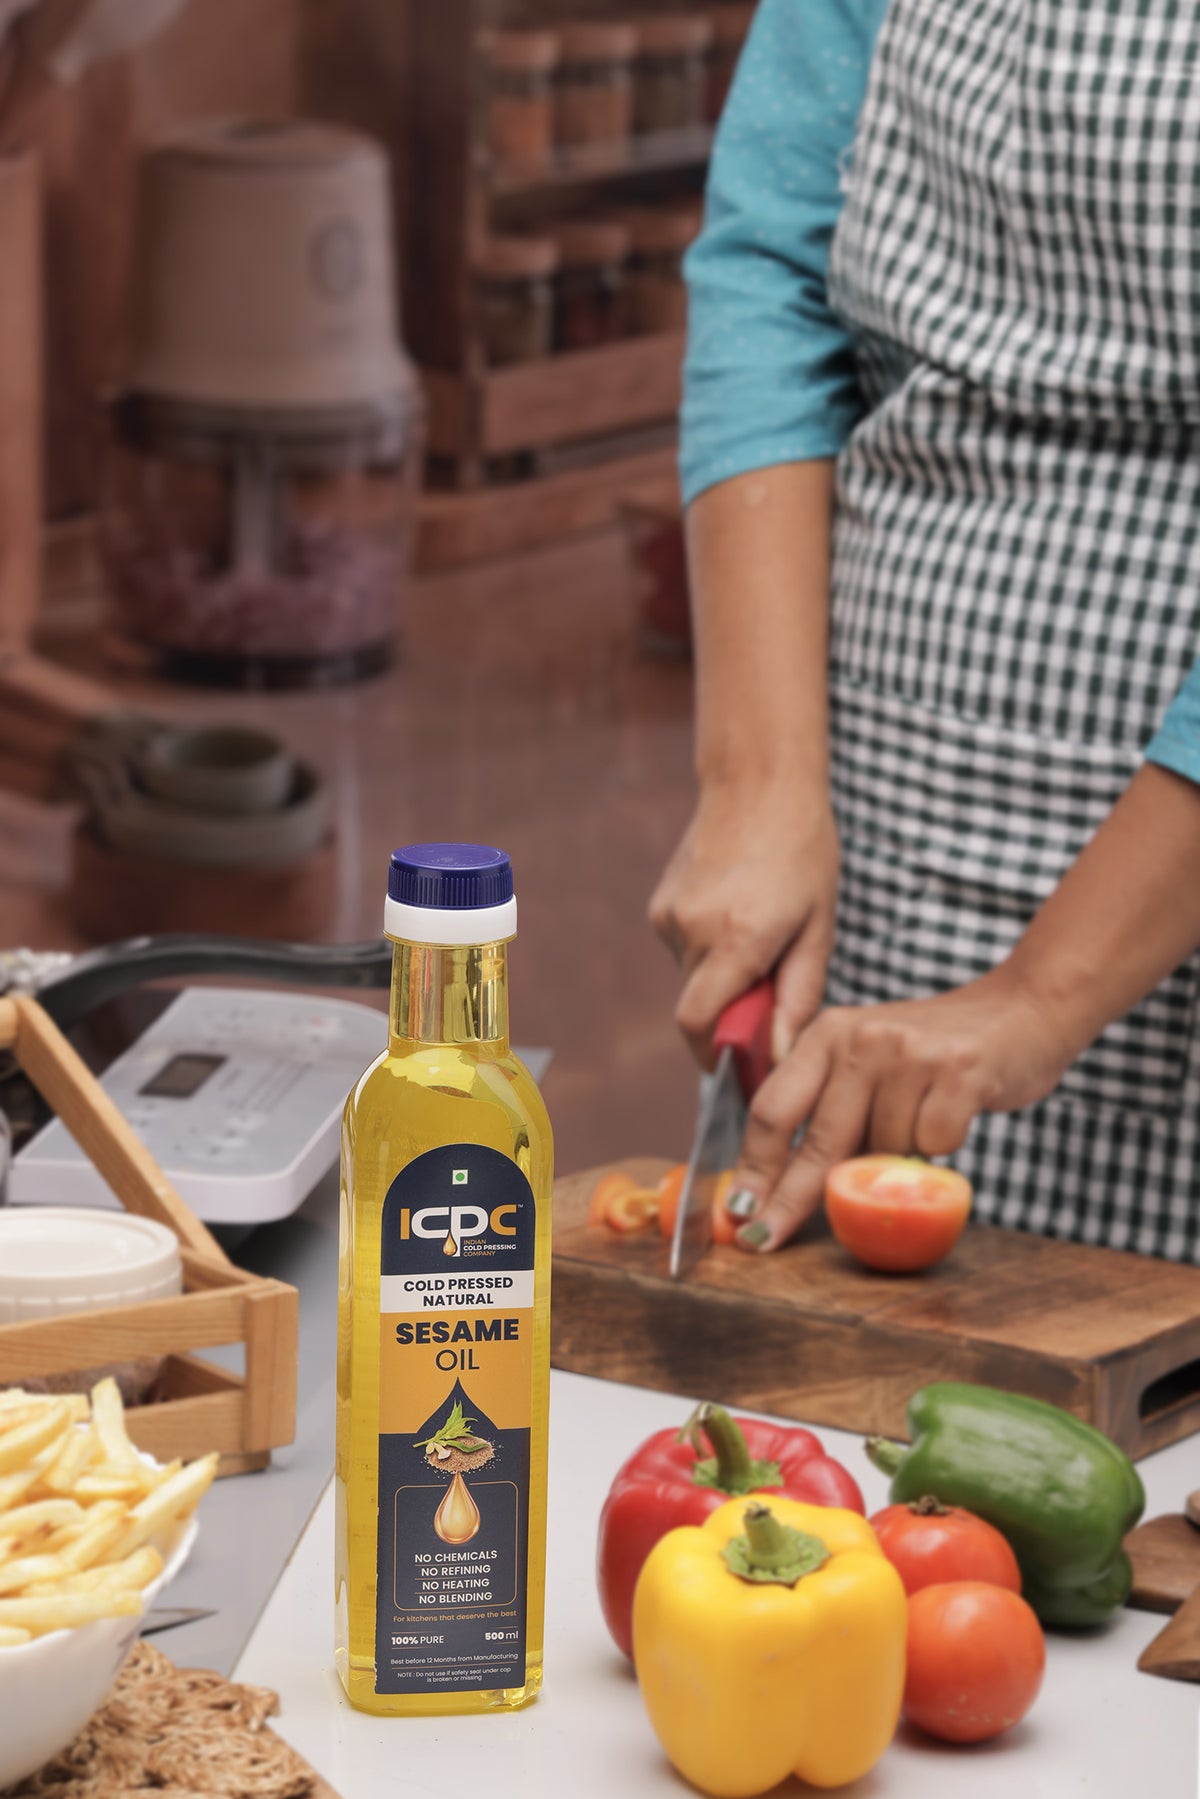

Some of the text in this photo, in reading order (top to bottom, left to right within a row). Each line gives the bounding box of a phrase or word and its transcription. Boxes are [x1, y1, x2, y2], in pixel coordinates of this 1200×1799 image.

[400, 1204, 517, 1257] ICPC
[403, 1277, 513, 1292] COLD PRESSED
[423, 1293, 494, 1307] NATURAL
[396, 1318, 519, 1345] SESAME
[435, 1348, 480, 1371] OIL
[414, 1550, 498, 1563] NO CHEMICALS
[421, 1564, 491, 1577] NO REFINING
[422, 1578, 490, 1591] NO HEATING
[419, 1592, 493, 1604] NO BLENDING
[393, 1615, 405, 1623] For
[391, 1635, 445, 1645] 100% PURE
[485, 1630, 519, 1640] 500 ml
[473, 1652, 519, 1661] Manufacturing
[451, 1668, 469, 1676] safety
